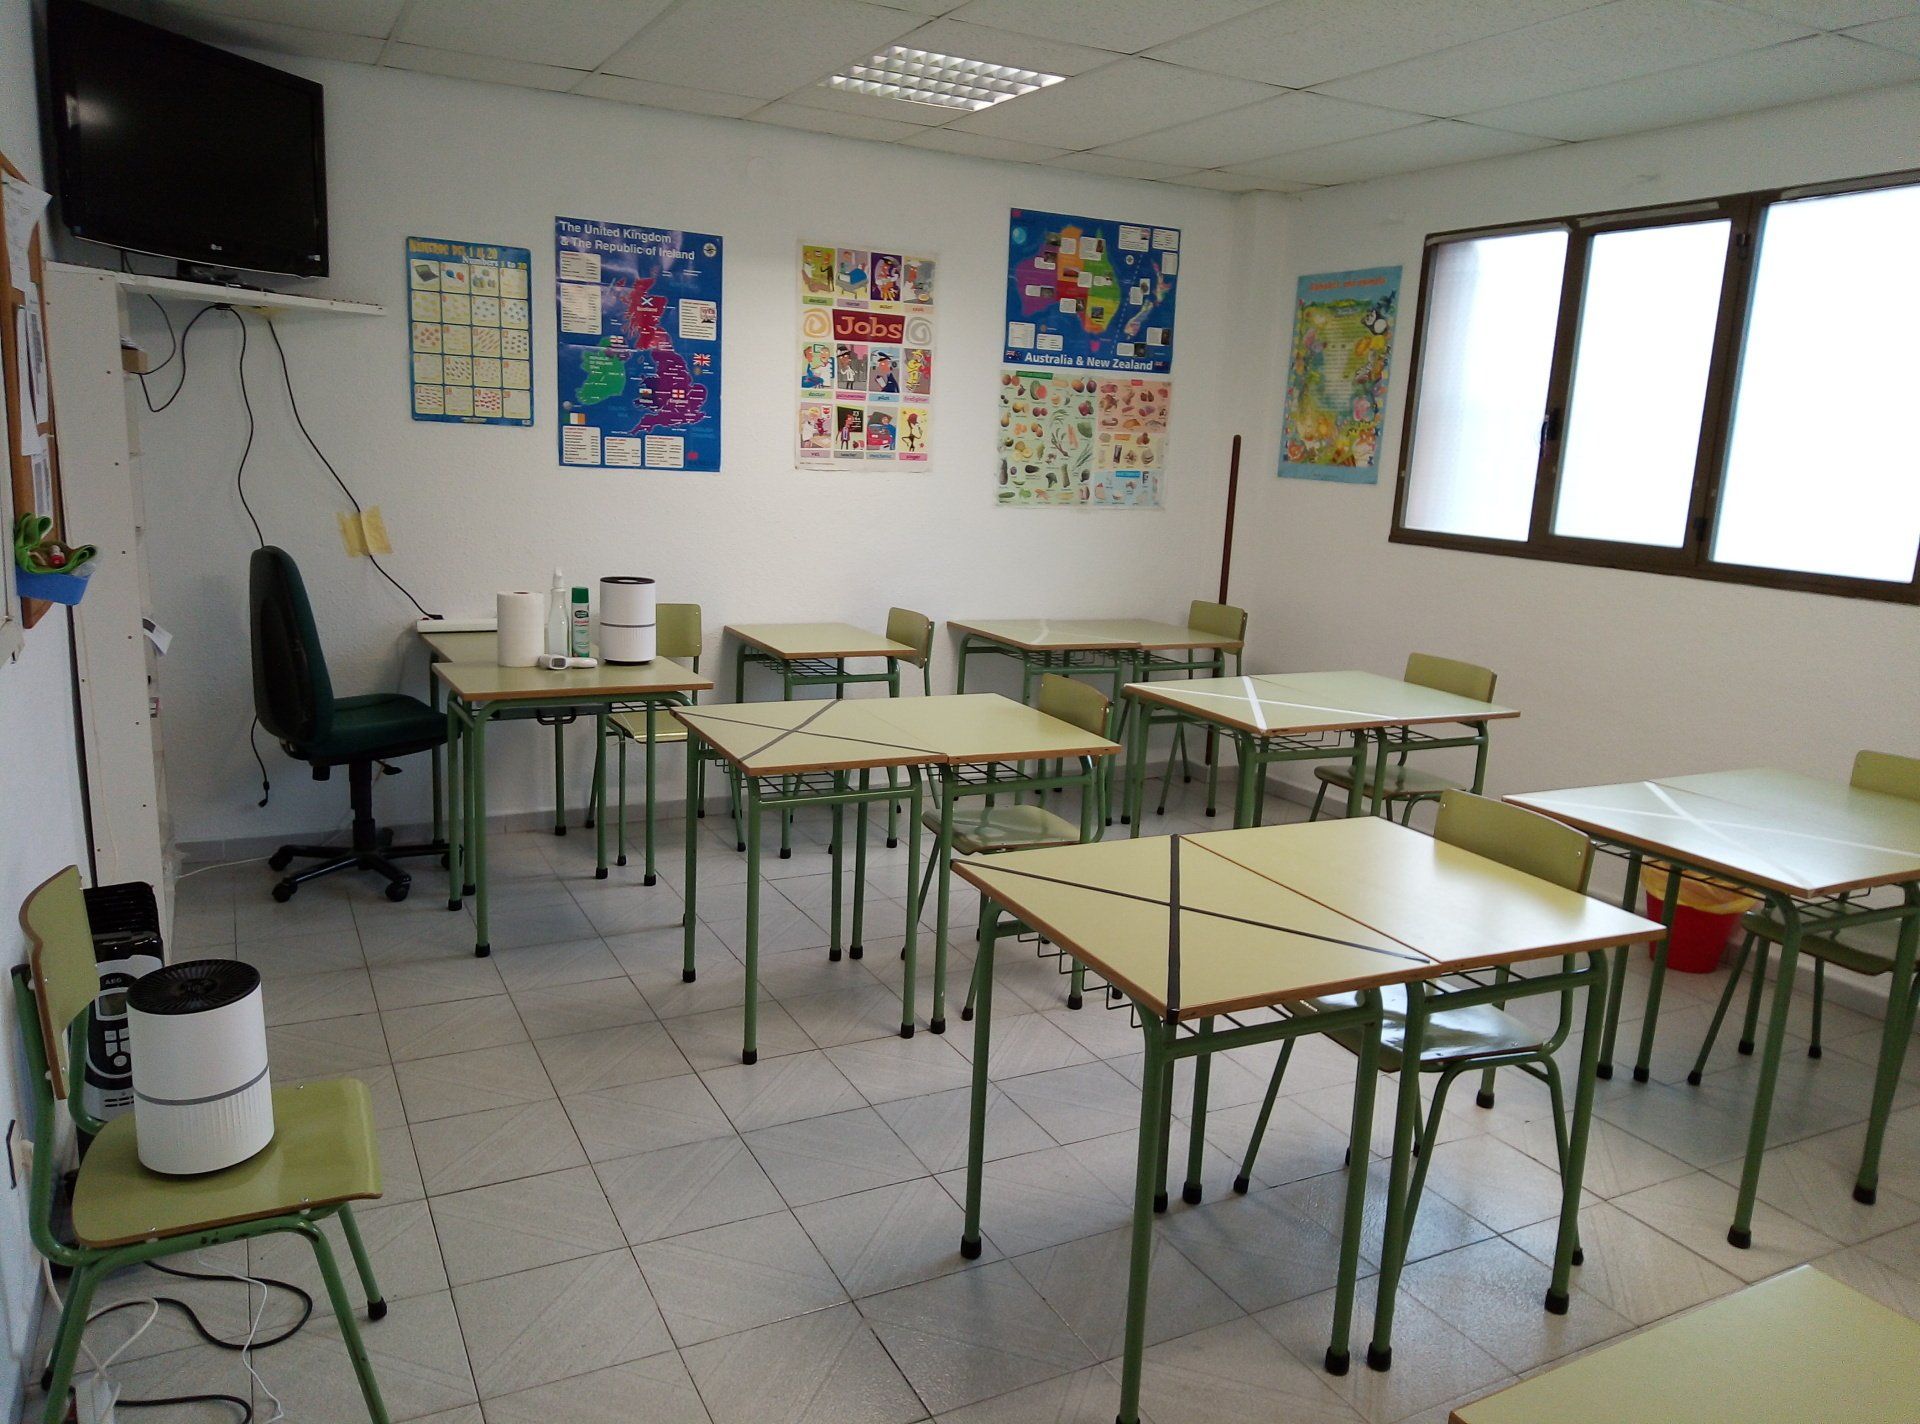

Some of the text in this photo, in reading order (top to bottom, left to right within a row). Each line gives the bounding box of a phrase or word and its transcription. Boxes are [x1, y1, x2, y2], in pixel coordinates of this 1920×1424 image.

[560, 221, 672, 243] The United Kingdom
[560, 236, 695, 260] & The Republic of Ireland
[836, 315, 903, 339] Jobs
[1024, 352, 1153, 371] Australia & New Zealand
